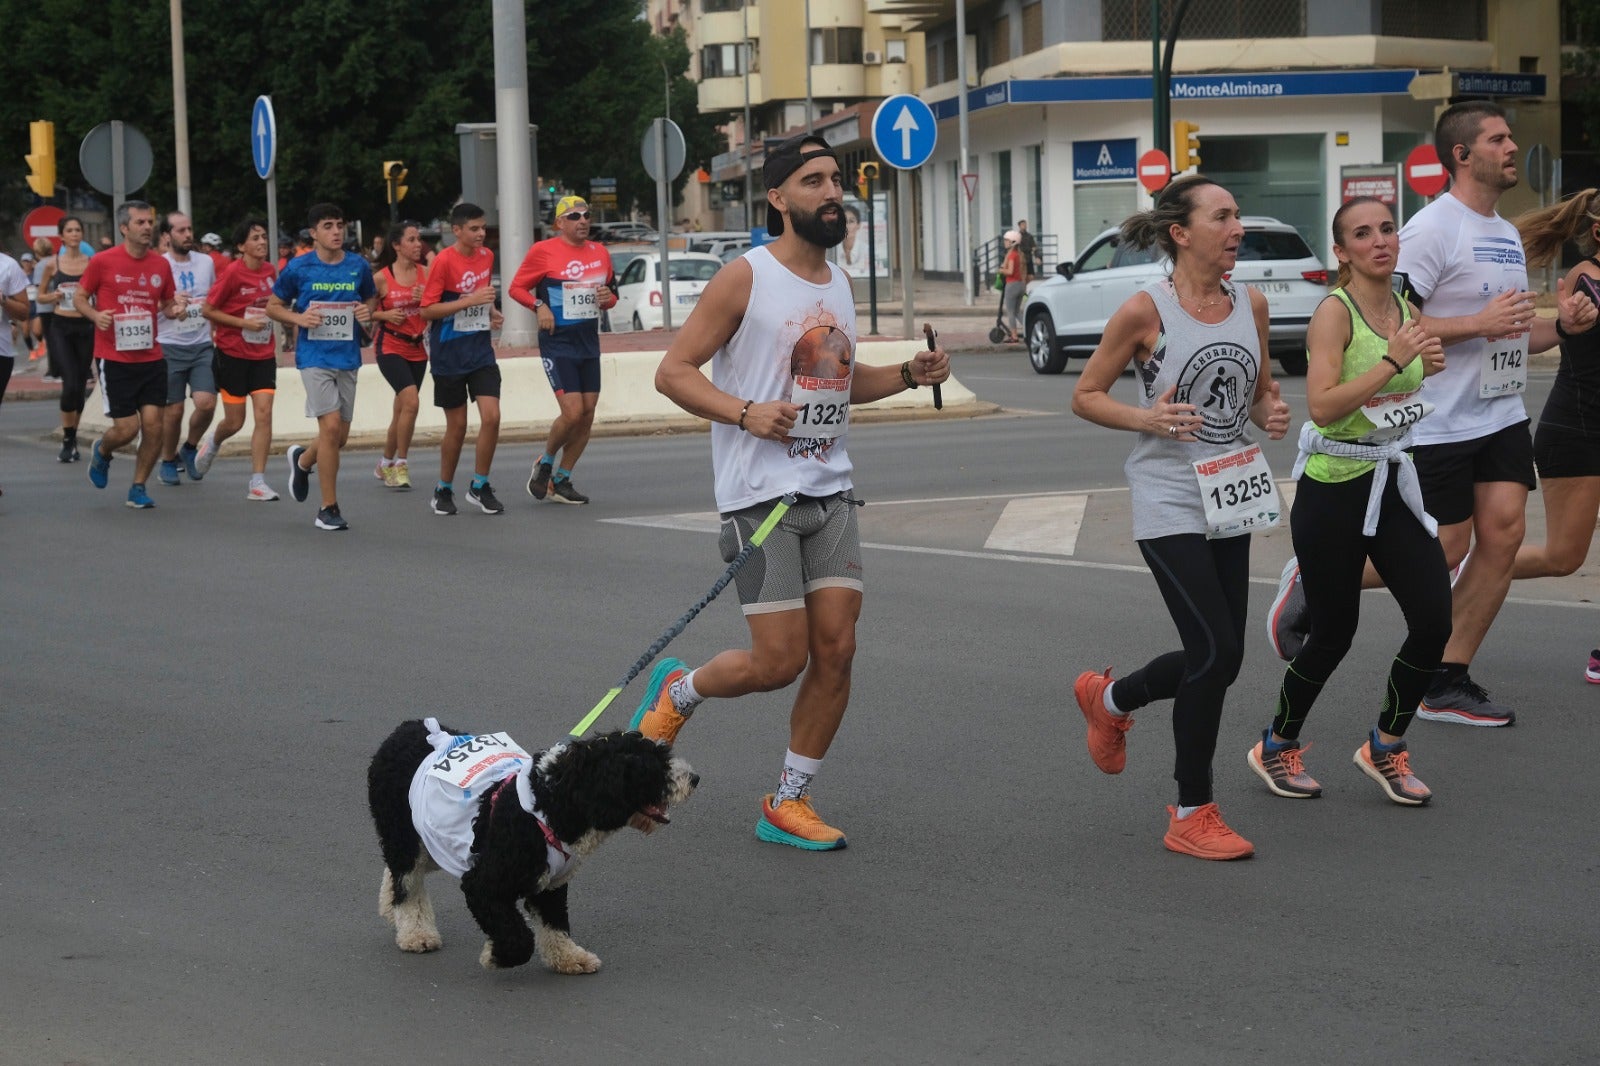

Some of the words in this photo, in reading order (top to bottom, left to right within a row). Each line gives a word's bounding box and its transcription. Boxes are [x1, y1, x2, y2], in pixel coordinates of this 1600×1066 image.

[1174, 82, 1283, 97] MonteAlminara
[1076, 167, 1135, 178] MonteAlminara
[312, 282, 355, 293] mayoral
[570, 294, 596, 305] 1362
[463, 306, 484, 317] 1361
[119, 325, 151, 337] 13354
[1193, 348, 1251, 371] CHURRIFIT
[1491, 349, 1522, 371] 1742
[1384, 403, 1424, 428] 1257
[1196, 460, 1219, 477] 42
[1210, 471, 1271, 509] 13255
[433, 734, 508, 772] 13254
